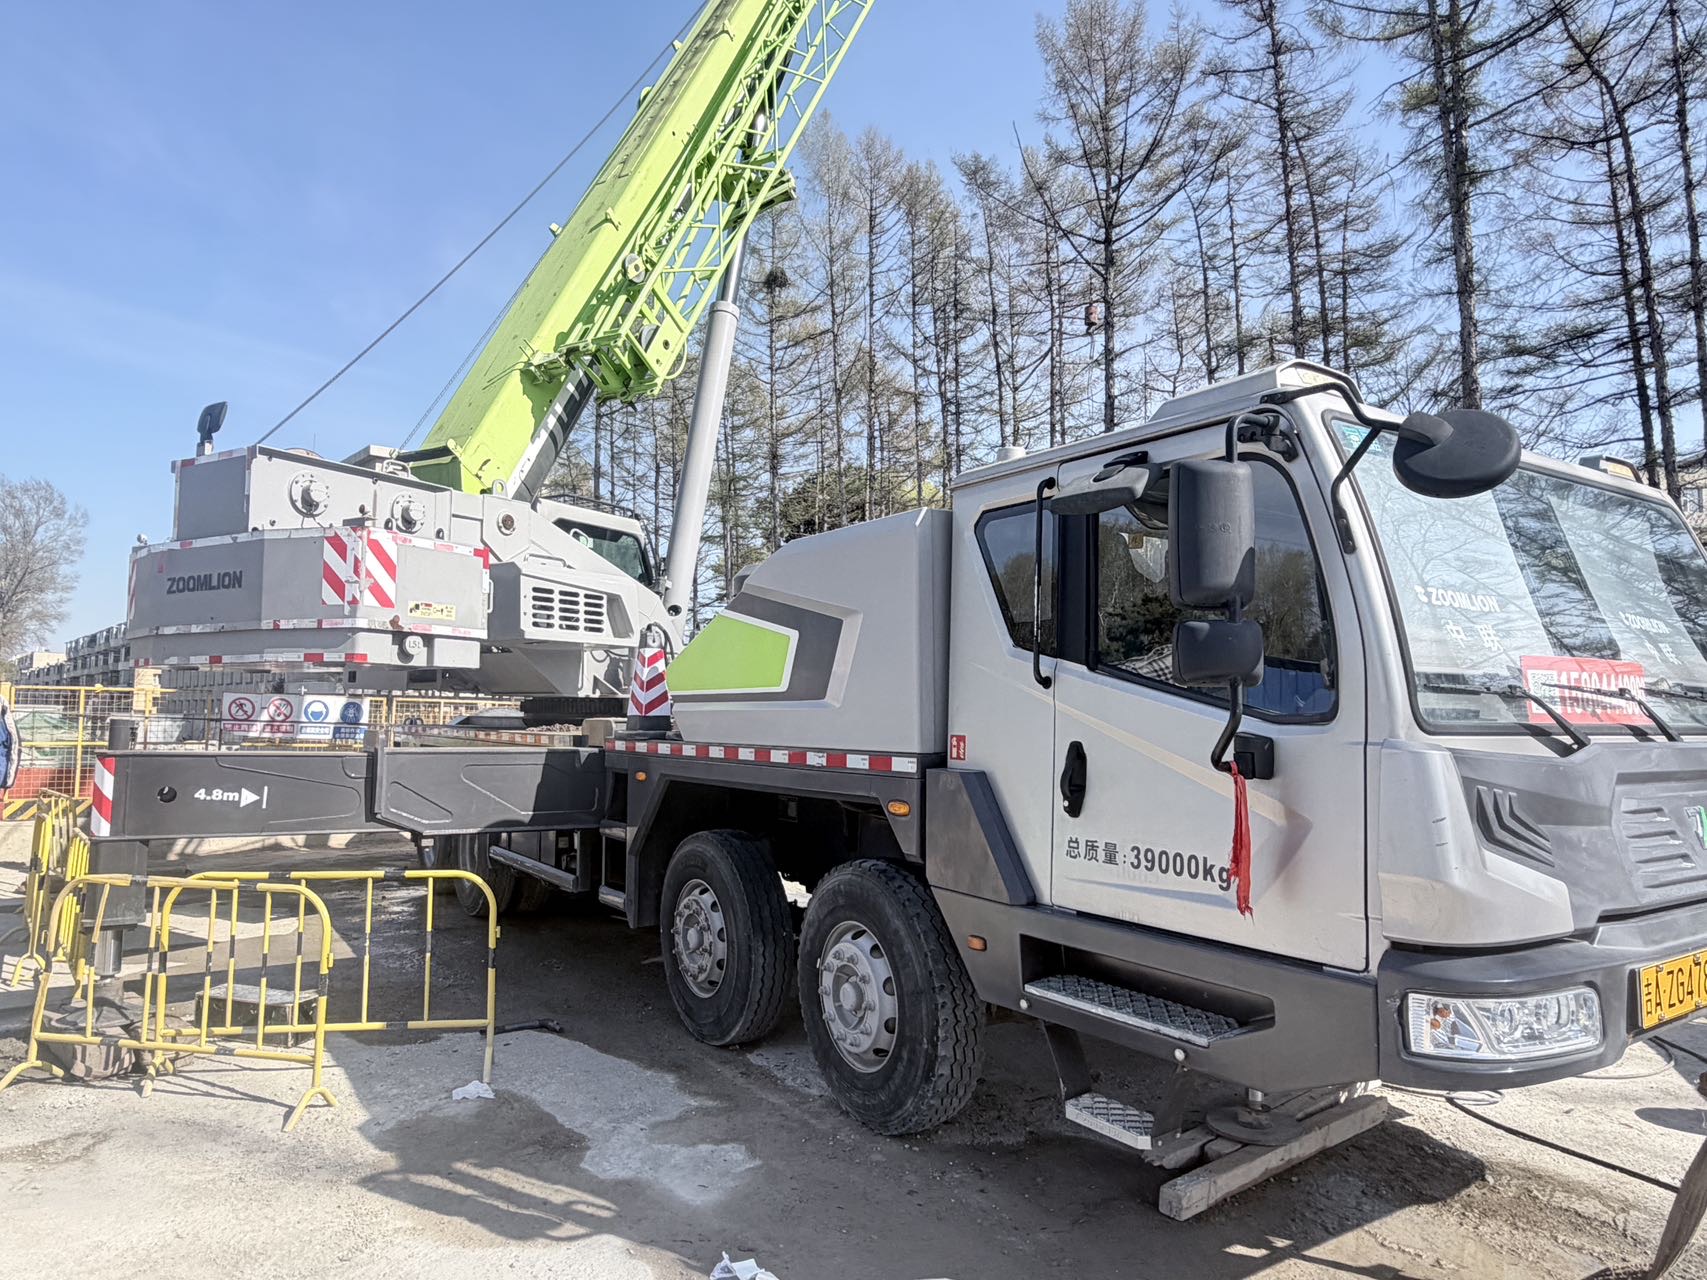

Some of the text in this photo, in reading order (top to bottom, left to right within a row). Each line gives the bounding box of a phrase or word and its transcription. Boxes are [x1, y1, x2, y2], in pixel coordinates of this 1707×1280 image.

[166, 570, 243, 595] ZOOMLION
[1426, 587, 1501, 613] ZOOMLION
[193, 788, 240, 802] 4.8m
[1066, 836, 1232, 892] 总质量:39000kg
